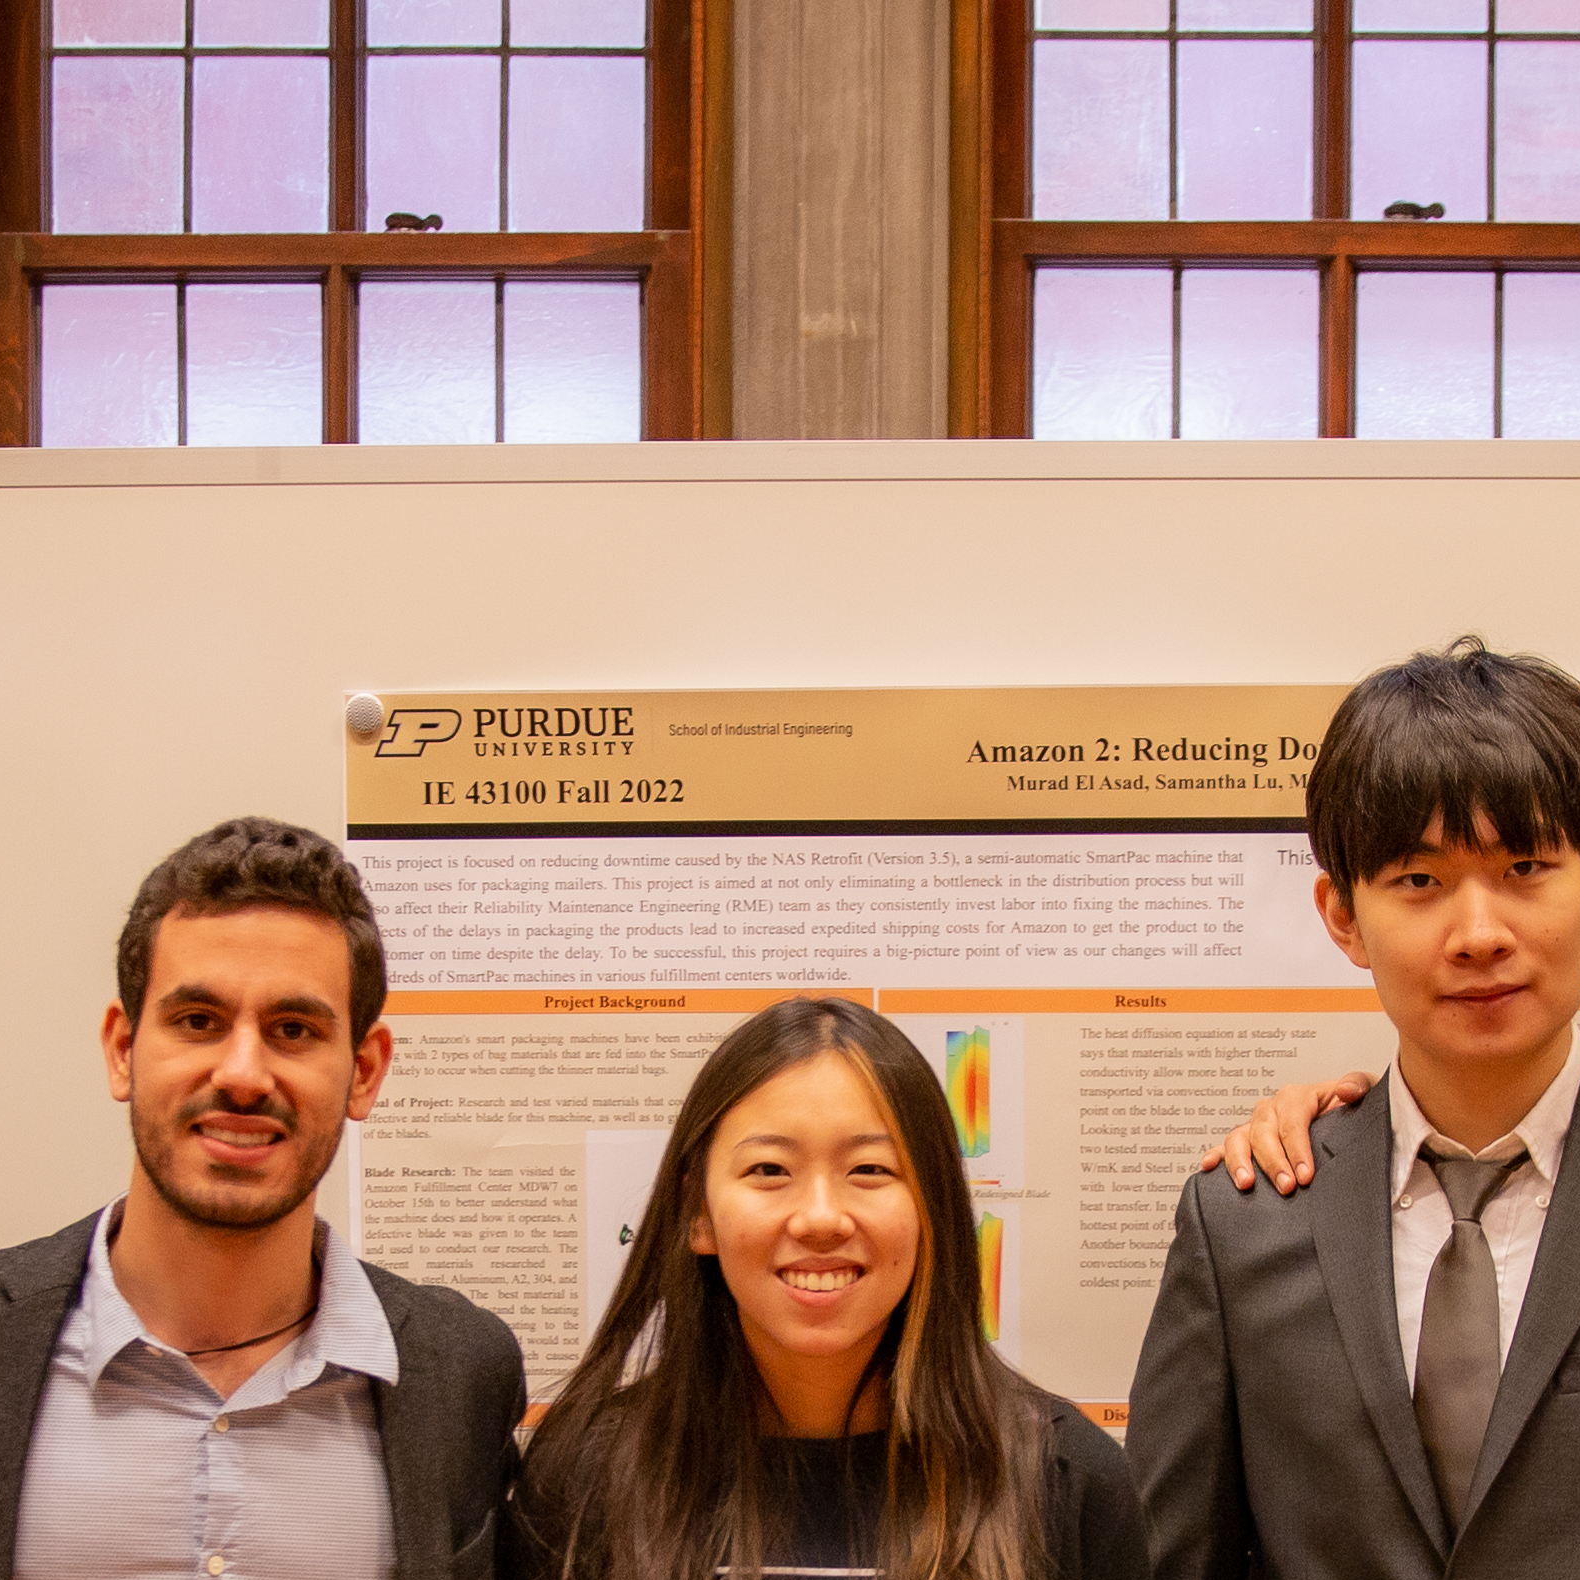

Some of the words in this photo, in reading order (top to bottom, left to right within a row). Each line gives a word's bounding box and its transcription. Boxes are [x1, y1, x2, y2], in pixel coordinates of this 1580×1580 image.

[473, 707, 633, 737] PURDUE
[669, 722, 708, 736] School
[711, 722, 722, 736] of
[725, 722, 779, 736] Industrial
[783, 722, 853, 738] Engineering
[474, 741, 633, 757] UNIVERSITY
[967, 740, 1084, 763] Amazon
[1096, 737, 1119, 762] 2:
[1133, 737, 1268, 768] Reducing
[1008, 775, 1068, 791] Murad
[1076, 774, 1094, 790] El
[1099, 775, 1149, 792] Asad,
[1156, 773, 1246, 790] Samantha
[1254, 774, 1283, 792] Lu,
[424, 781, 455, 805] IE
[466, 780, 546, 805] 43100
[558, 779, 609, 804] Fall
[621, 779, 684, 803] 2022
[362, 855, 391, 869] This
[397, 855, 442, 872] project
[448, 855, 458, 869] is
[464, 854, 514, 869] focused
[519, 858, 535, 868] on
[541, 854, 598, 871] reducing
[604, 853, 670, 868] downtime
[675, 853, 720, 867] caused
[725, 853, 742, 870] by
[747, 852, 767, 866] the
[773, 852, 805, 866] NAS
[812, 852, 862, 866] Retrofit
[868, 851, 924, 867] (Version
[929, 851, 960, 867] 3.5),
[965, 855, 972, 865] a
[978, 850, 1081, 865] semi-automatic
[1086, 850, 1150, 864] SmartPac
[1156, 850, 1213, 864] machine
[1218, 850, 1243, 863] that
[1277, 849, 1314, 866] This
[364, 880, 418, 892] Amazon
[424, 881, 452, 891] uses
[458, 878, 477, 891] for
[482, 878, 549, 895] packaging
[555, 876, 607, 891] mailers.
[612, 876, 642, 890] This
[647, 876, 693, 893] project
[699, 876, 709, 890] is
[715, 875, 755, 890] aimed
[761, 878, 773, 889] at
[778, 877, 799, 888] not
[804, 875, 834, 892] only
[839, 875, 915, 892] eliminating
[921, 878, 928, 888] a
[933, 874, 1003, 887] bottleneck
[1009, 874, 1021, 887] in
[1027, 874, 1047, 887] the
[1053, 873, 1129, 887] distribution
[1135, 877, 1186, 890] process
[1191, 873, 1212, 887] but
[1218, 872, 1243, 887] will
[374, 905, 390, 915] so
[395, 901, 432, 915] affect
[438, 901, 468, 915] their
[474, 900, 542, 917] Reliability
[549, 900, 633, 914] Maintenance
[640, 899, 720, 916] Engineering
[726, 898, 773, 914] (RME)
[779, 901, 810, 912] team
[817, 902, 830, 912] as
[836, 898, 865, 915] they
[870, 897, 950, 914] consistently
[956, 897, 996, 911] invest
[1002, 897, 1036, 910] labor
[1042, 897, 1067, 910] into
[1074, 897, 1112, 914] fixing
[1119, 897, 1139, 910] the
[1145, 897, 1212, 910] machines.
[1218, 897, 1244, 910] The
[380, 926, 407, 938] ects
[413, 924, 429, 937] of
[433, 924, 453, 938] the
[459, 924, 501, 941] delays
[508, 923, 519, 936] in
[526, 923, 593, 940] packaging
[600, 923, 620, 936] the
[626, 922, 683, 939] products
[690, 922, 717, 936] lead
[723, 925, 736, 936] to
[743, 921, 805, 936] increased
[811, 921, 876, 938] expedited
[883, 921, 940, 938] shipping
[946, 923, 979, 934] costs
[986, 920, 1005, 934] for
[1011, 921, 1067, 934] Amazon
[1074, 923, 1086, 934] to
[1093, 923, 1113, 937] get
[1119, 920, 1140, 934] the
[1146, 920, 1197, 937] product
[1204, 923, 1217, 934] to
[1223, 920, 1243, 933] the
[388, 970, 425, 983] dreds
[429, 970, 444, 984] of
[447, 970, 509, 983] SmartPac
[514, 969, 575, 983] machines
[580, 969, 592, 983] in
[597, 968, 645, 982] various
[651, 968, 721, 982] fulfillment
[725, 971, 772, 982] centers
[776, 967, 851, 981] worldwide.
[545, 995, 594, 1011] Project
[600, 995, 685, 1011] Background
[1115, 995, 1166, 1008] Results
[365, 1167, 395, 1177] Blade
[402, 1167, 455, 1177] Research:
[463, 1167, 482, 1177] The
[520, 1166, 553, 1177] visited
[560, 1166, 575, 1177] the
[365, 1182, 407, 1192] Amazon
[478, 1181, 512, 1192] Center
